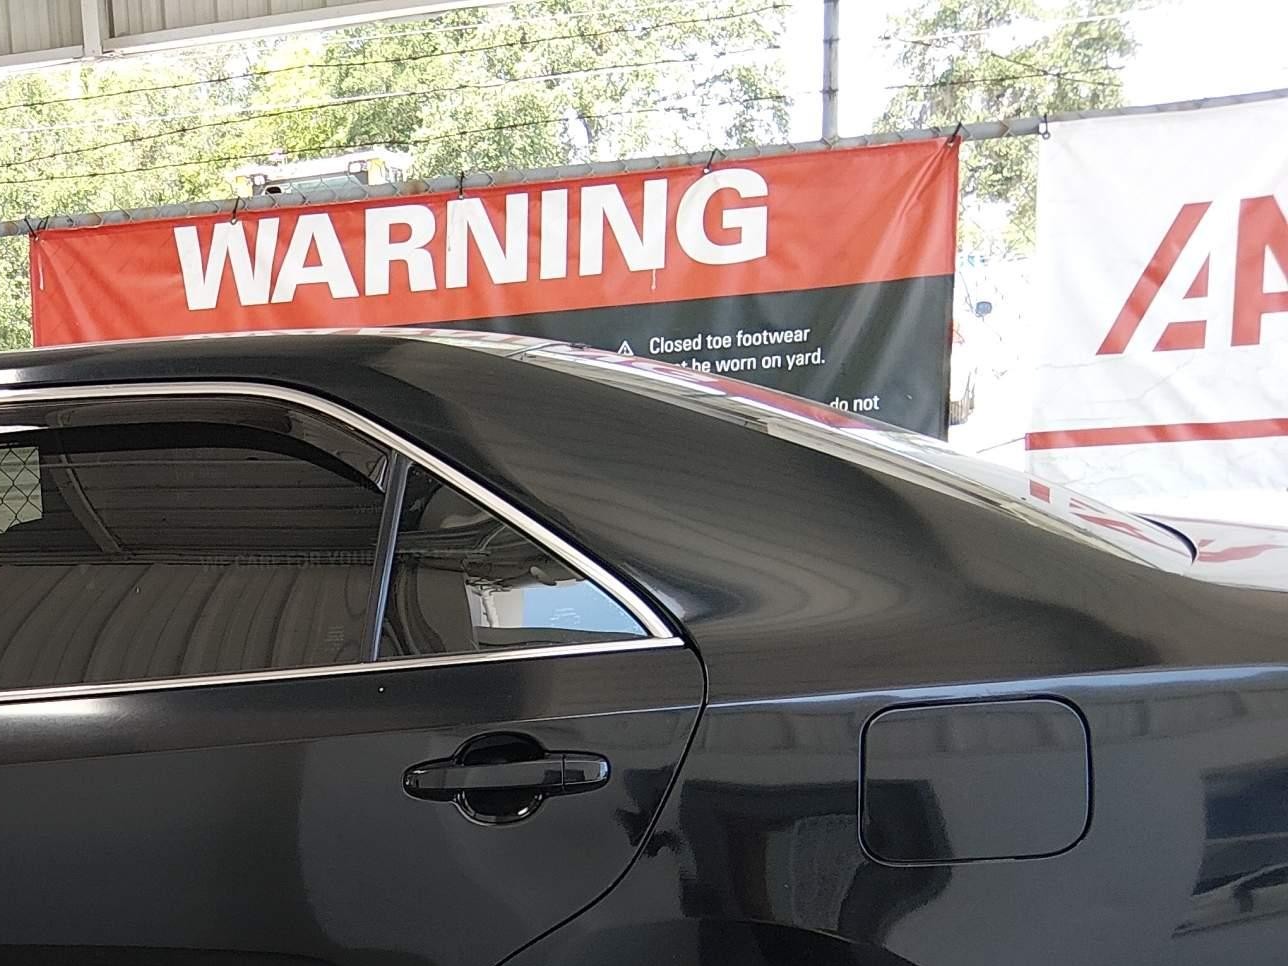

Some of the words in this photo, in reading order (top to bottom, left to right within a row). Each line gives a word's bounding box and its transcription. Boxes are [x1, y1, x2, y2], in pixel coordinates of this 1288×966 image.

[174, 168, 769, 312] WARNING
[649, 335, 702, 355] Closed
[706, 333, 732, 352] toe
[736, 326, 811, 348] footwear
[715, 356, 756, 372] worn
[761, 354, 782, 369] on
[785, 348, 826, 371] yard.
[853, 395, 880, 412] not
